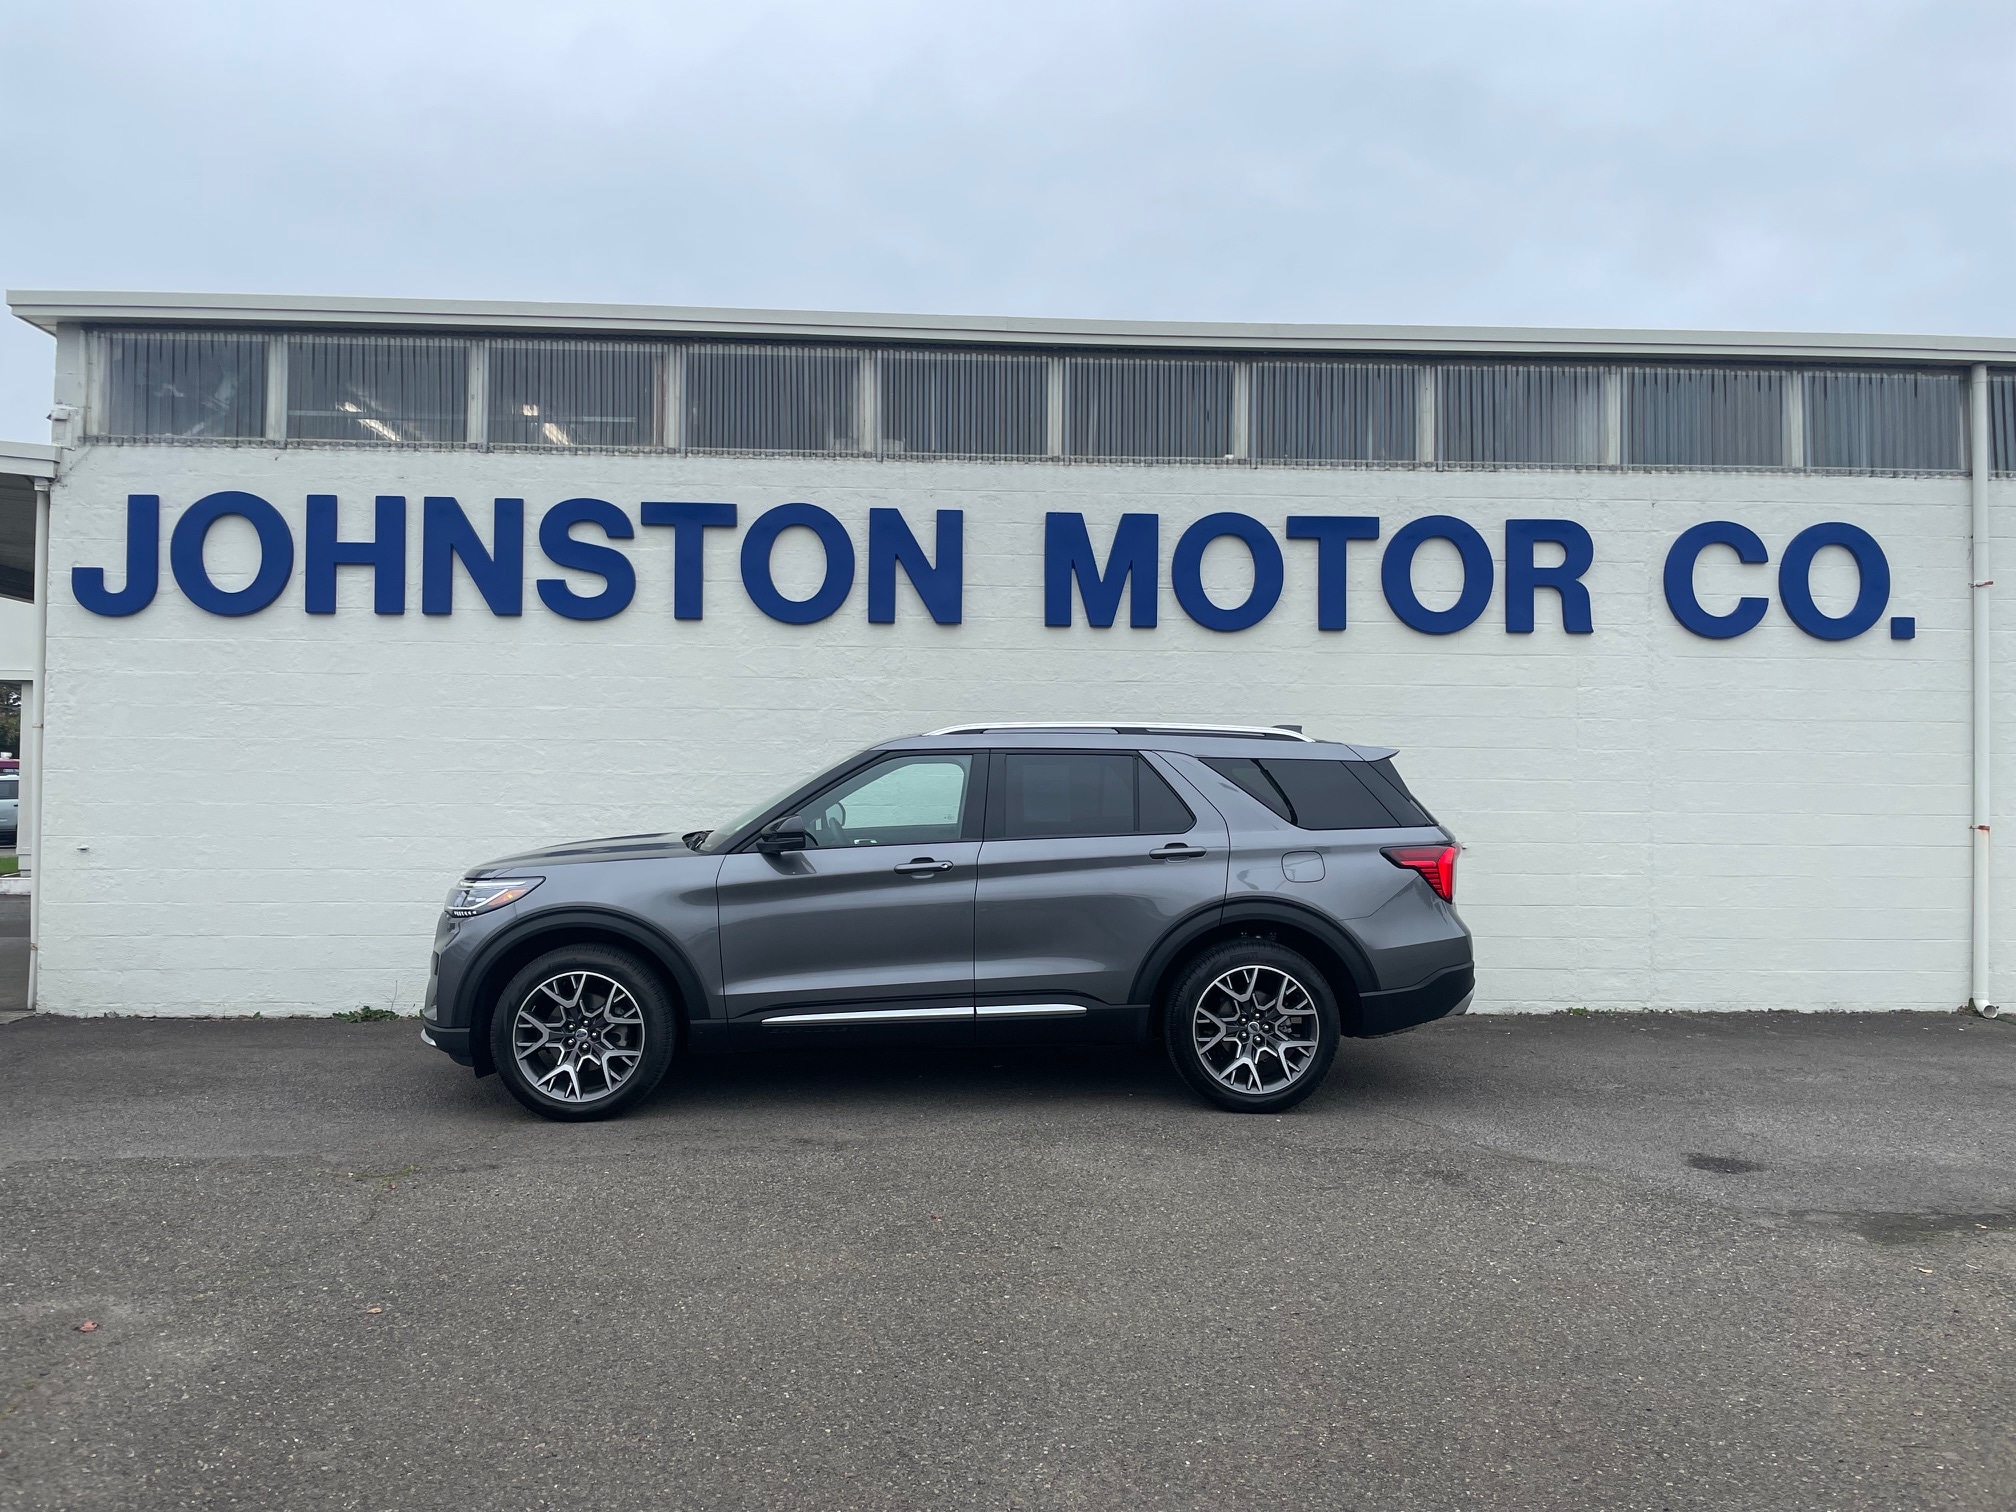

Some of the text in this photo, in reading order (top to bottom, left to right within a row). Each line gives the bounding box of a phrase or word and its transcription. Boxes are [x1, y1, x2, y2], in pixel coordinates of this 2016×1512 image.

[72, 491, 1915, 641] JOHNSTON MOTOR CO.
